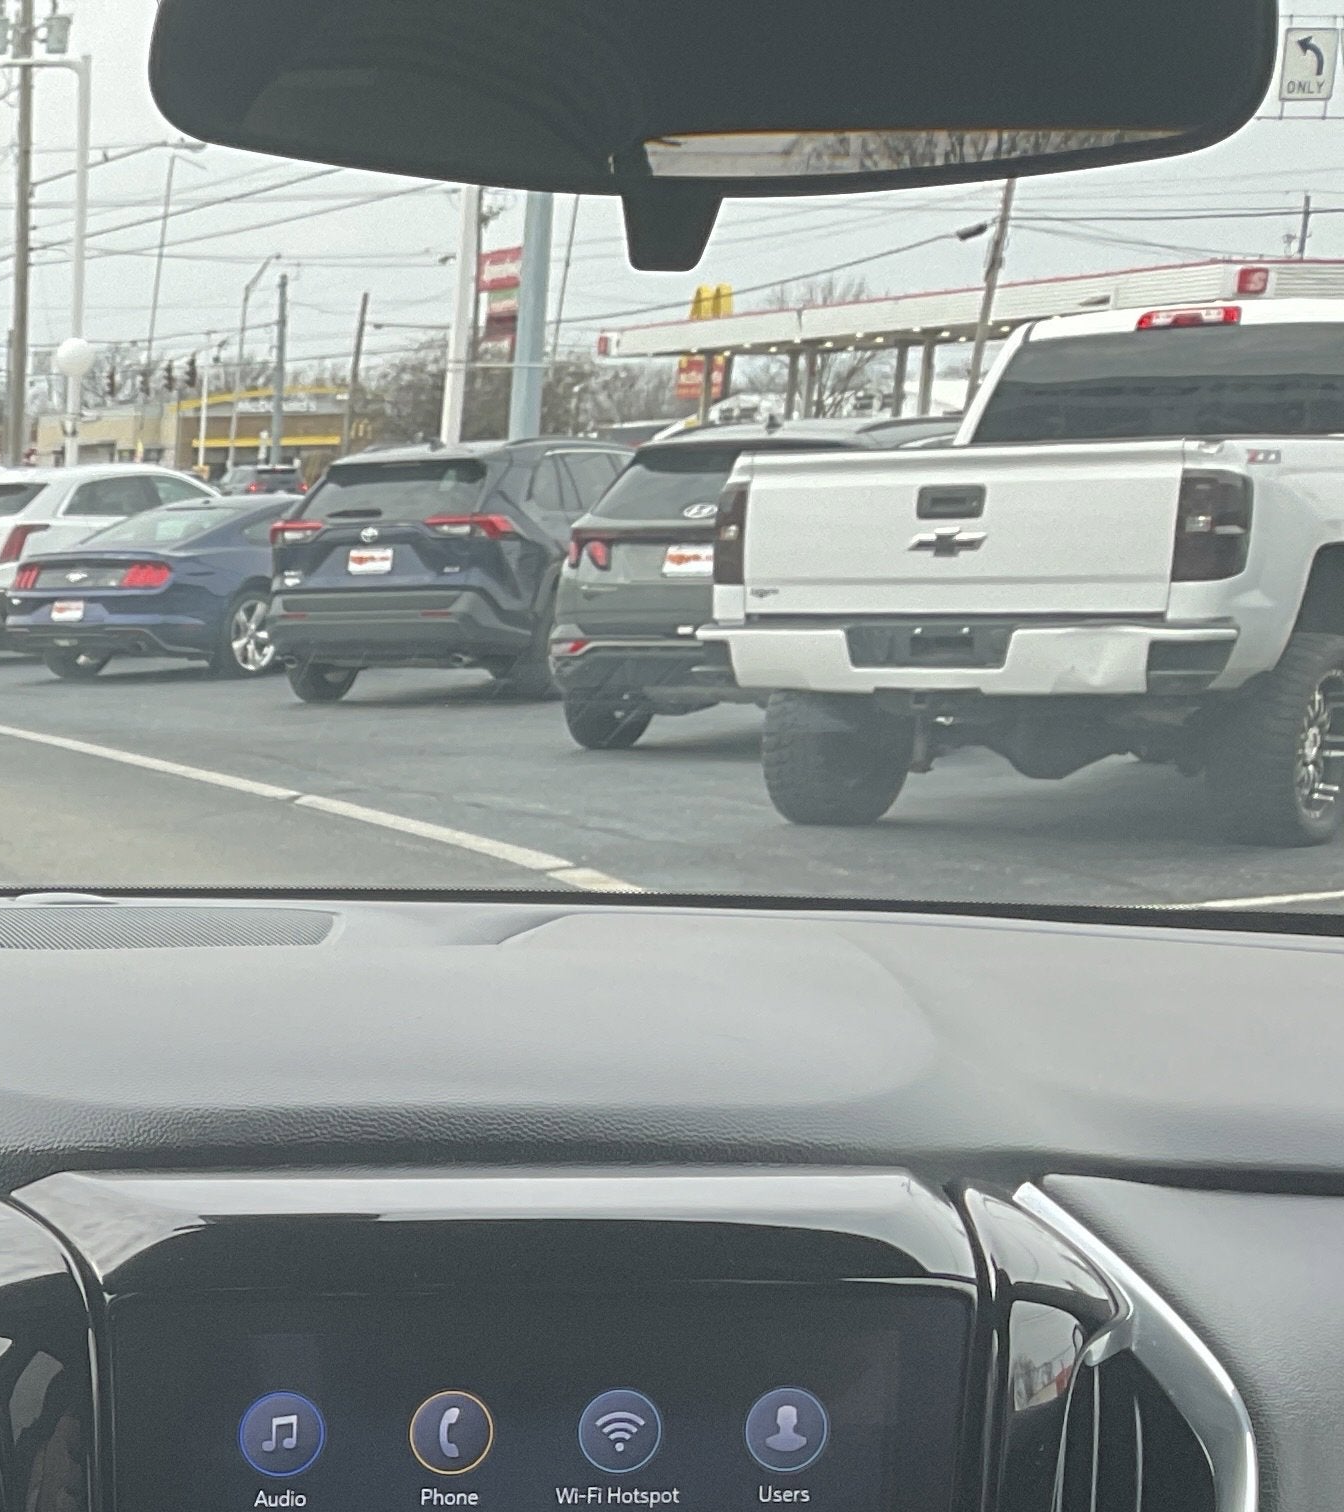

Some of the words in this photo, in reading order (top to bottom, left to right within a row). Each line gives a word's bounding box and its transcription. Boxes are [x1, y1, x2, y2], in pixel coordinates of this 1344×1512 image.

[1287, 81, 1325, 94] ONLY
[254, 1490, 307, 1507] Audio
[420, 1488, 479, 1505] Phone
[555, 1487, 602, 1504] Wi-Fi
[606, 1487, 680, 1508] Hotspot
[758, 1485, 810, 1502] Users
